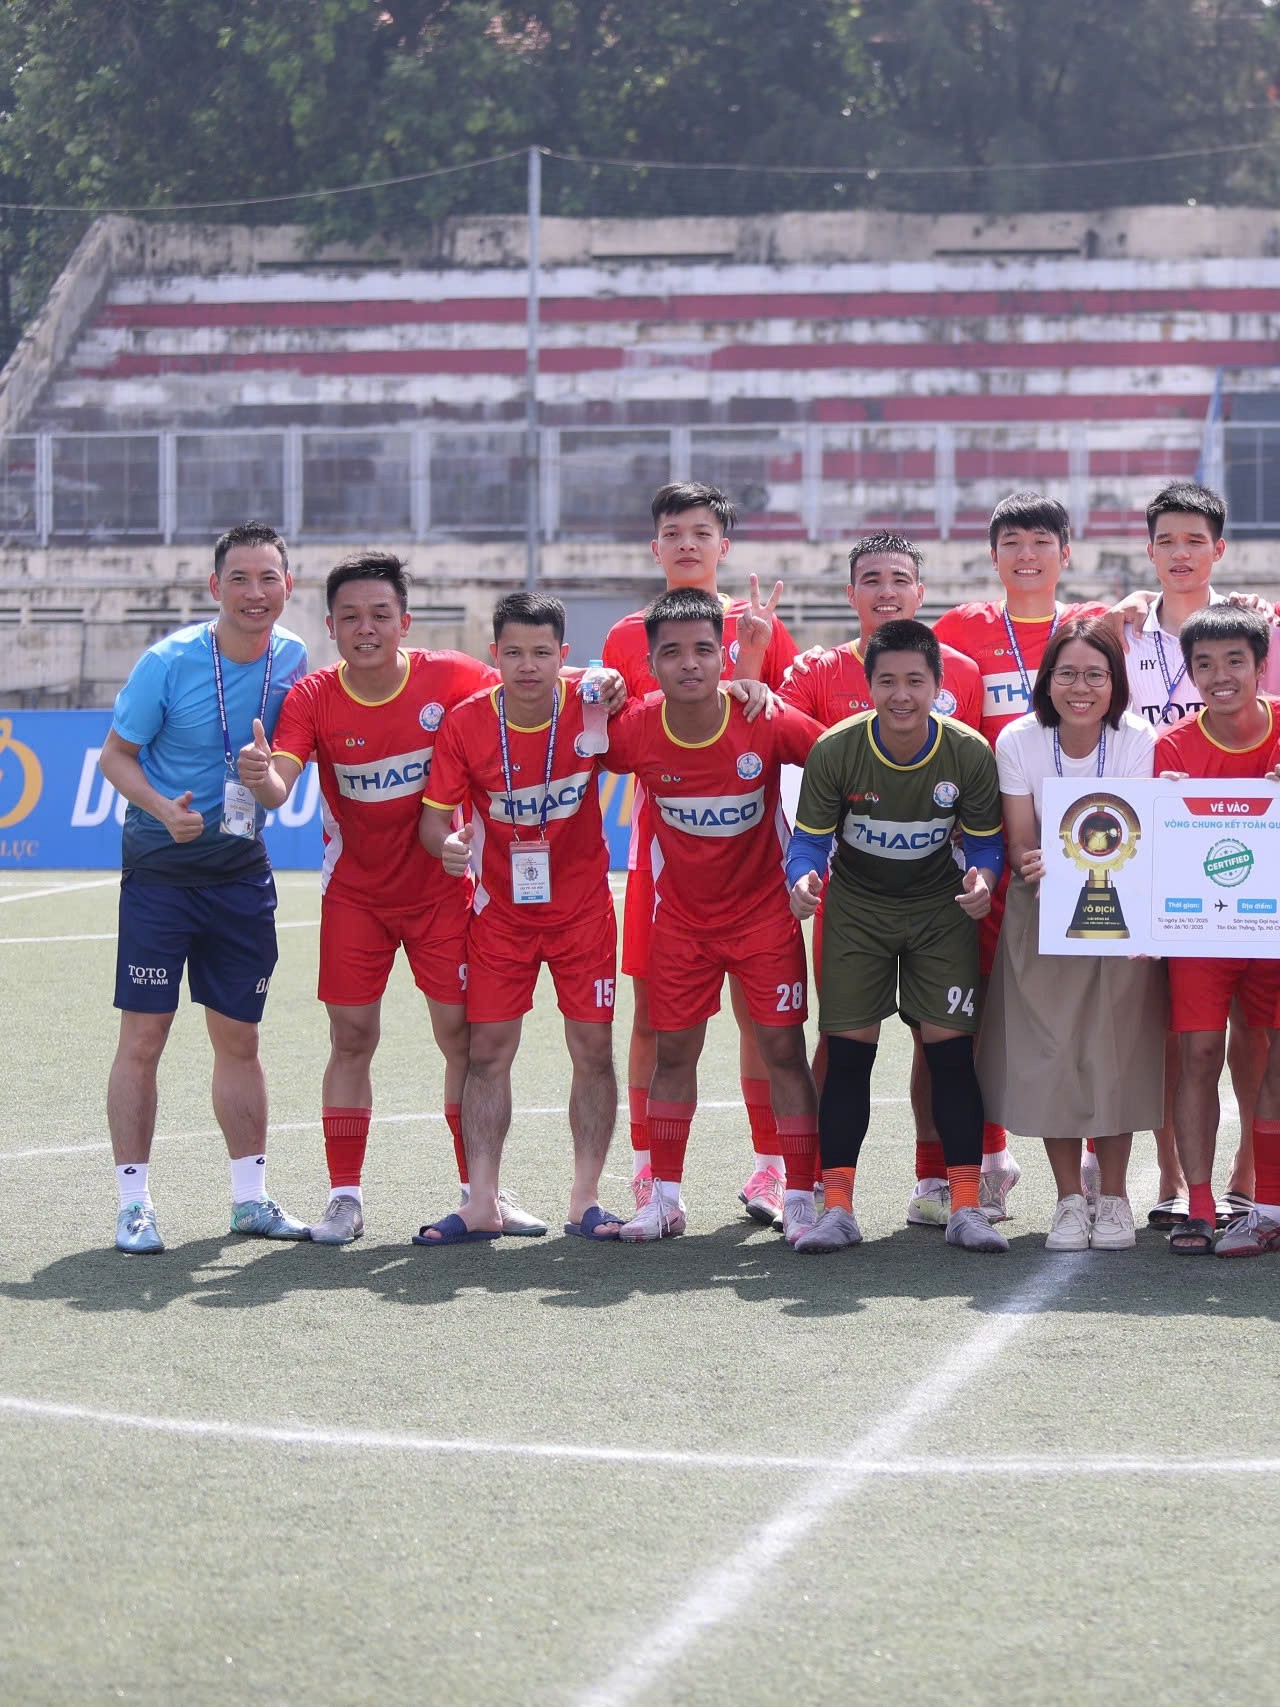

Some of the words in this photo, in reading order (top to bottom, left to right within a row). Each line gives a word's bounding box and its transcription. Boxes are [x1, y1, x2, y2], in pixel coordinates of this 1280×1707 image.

[1140, 660, 1157, 670] HY
[1142, 703, 1208, 725] TOT
[663, 802, 757, 826] THACO
[1226, 801, 1250, 813] VÀO
[1164, 819, 1190, 829] VÒNG
[1191, 820, 1223, 829] CHUNG
[1224, 818, 1241, 829] KẾT
[1241, 819, 1266, 829] TOÀN
[853, 823, 948, 850] THACO
[1207, 854, 1250, 872] CERTIFIED
[1082, 904, 1093, 913] VÔ
[1095, 906, 1115, 915] ĐỊCH
[128, 964, 167, 978] TOTO
[132, 977, 148, 985] VIET
[151, 978, 168, 986] NAM
[594, 978, 614, 1008] 15
[776, 981, 803, 1012] 28
[947, 986, 974, 1017] 94
